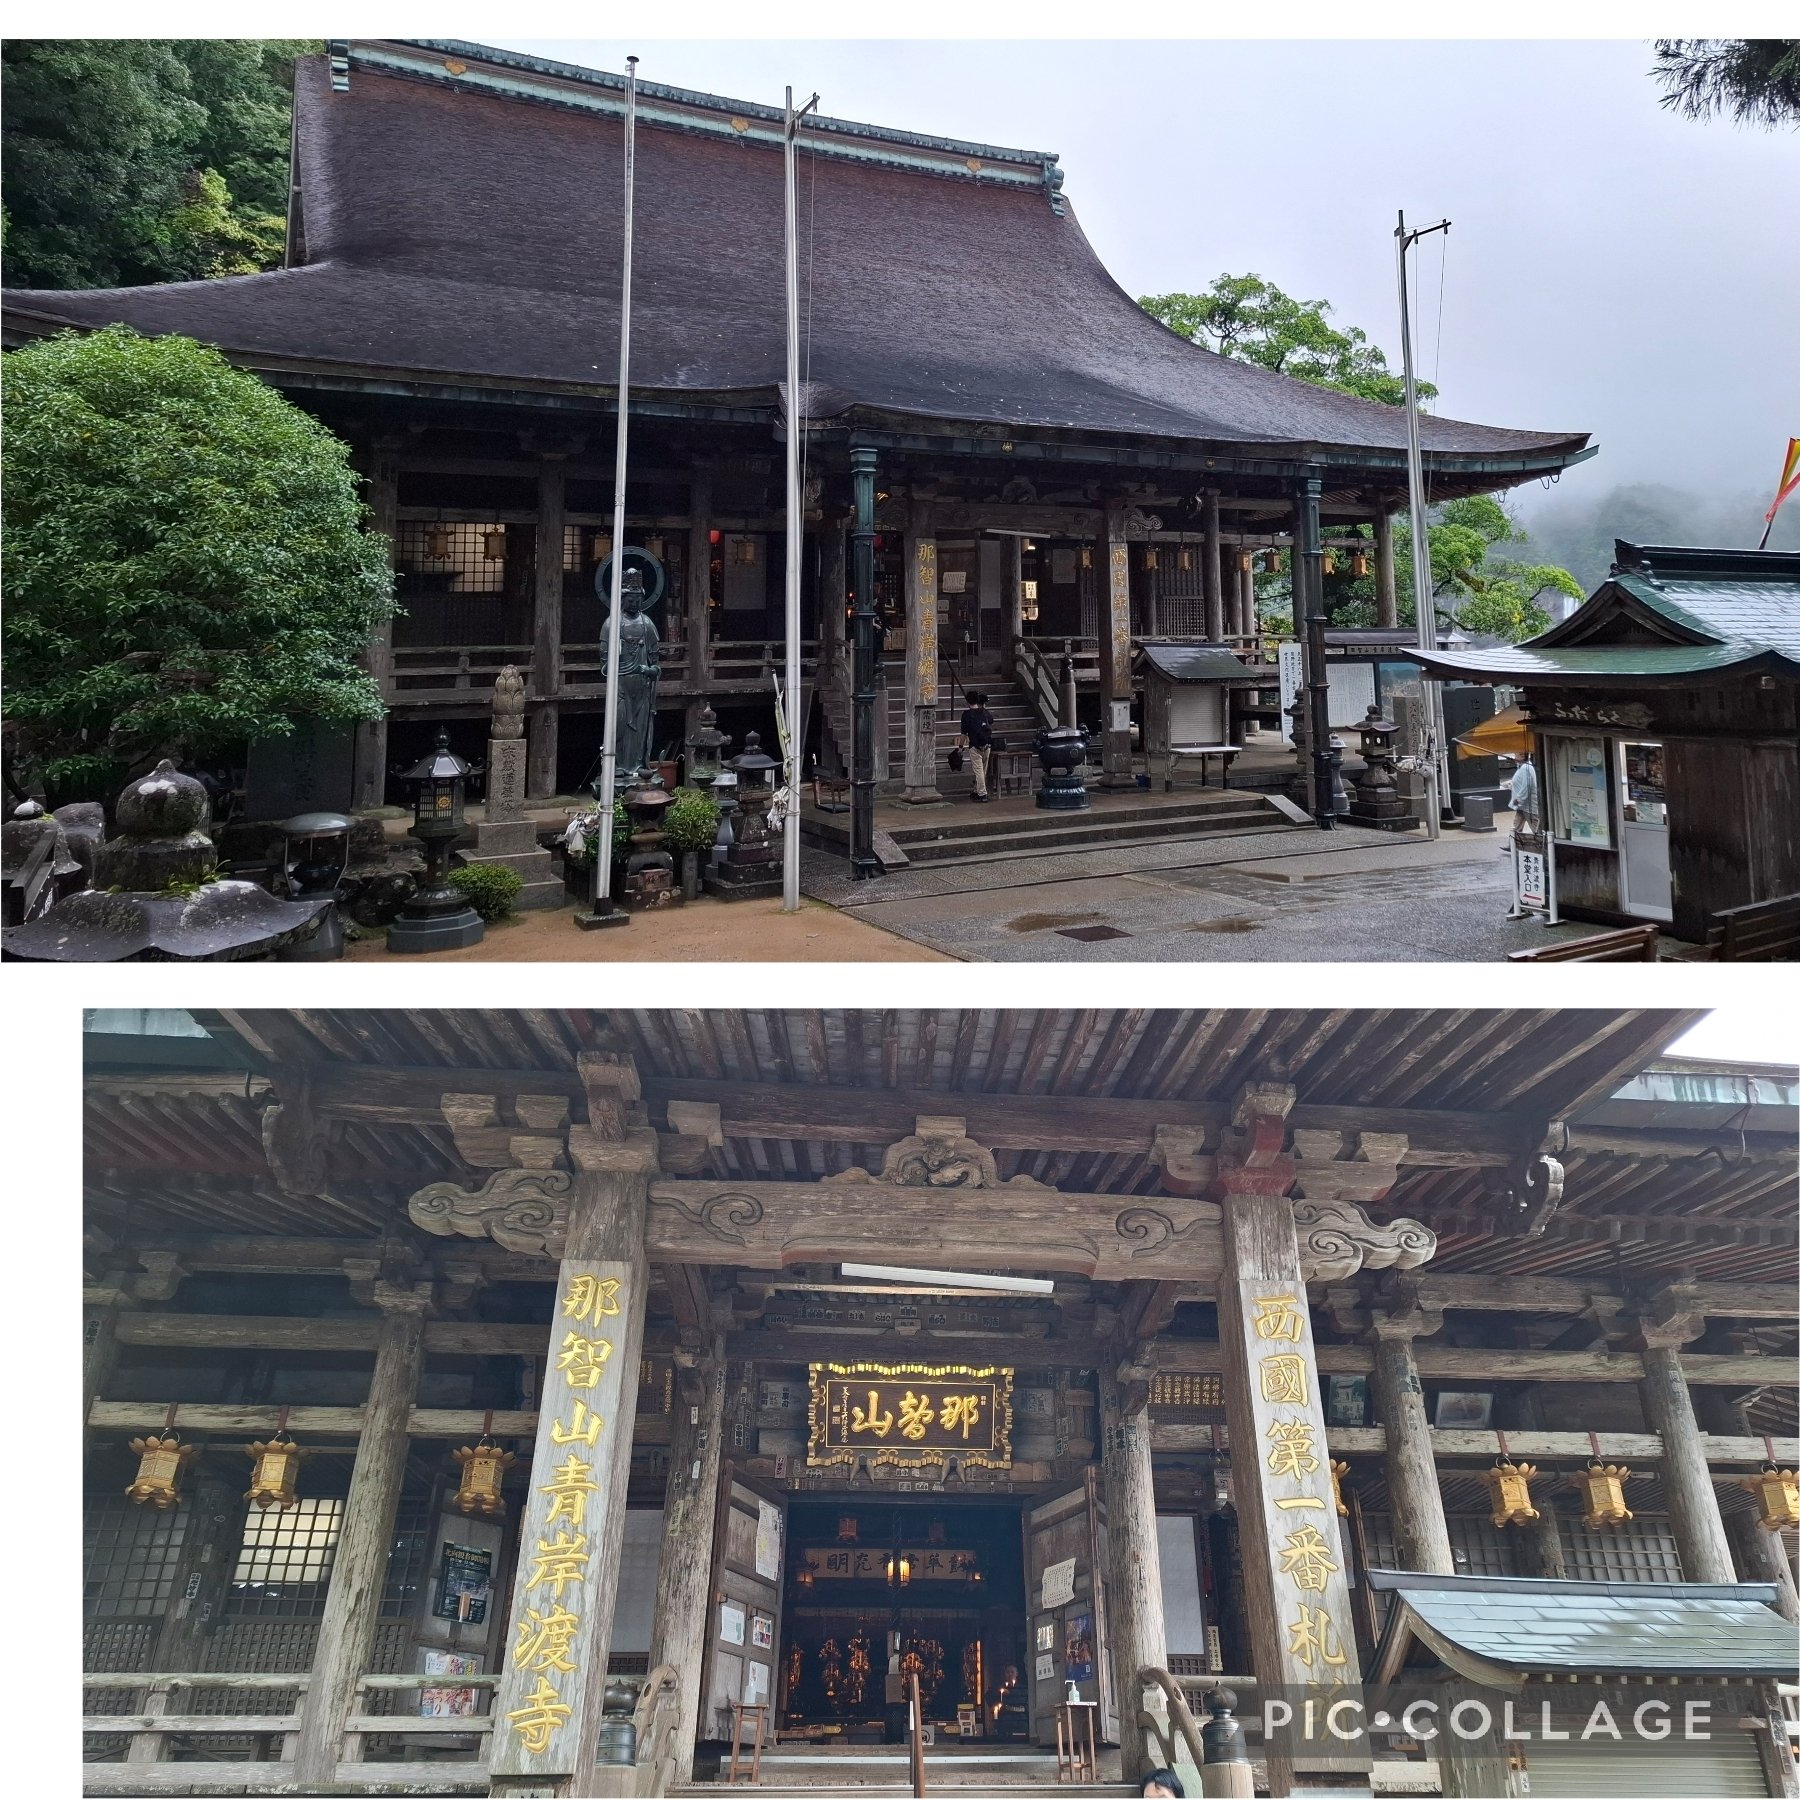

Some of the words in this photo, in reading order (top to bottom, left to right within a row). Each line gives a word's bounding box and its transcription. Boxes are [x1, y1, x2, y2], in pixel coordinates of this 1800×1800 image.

[917, 543, 936, 699] 那智山青岸渡寺
[1522, 854, 1532, 892] 本堂入口
[507, 1272, 622, 1755] 那智山青岸渡寺
